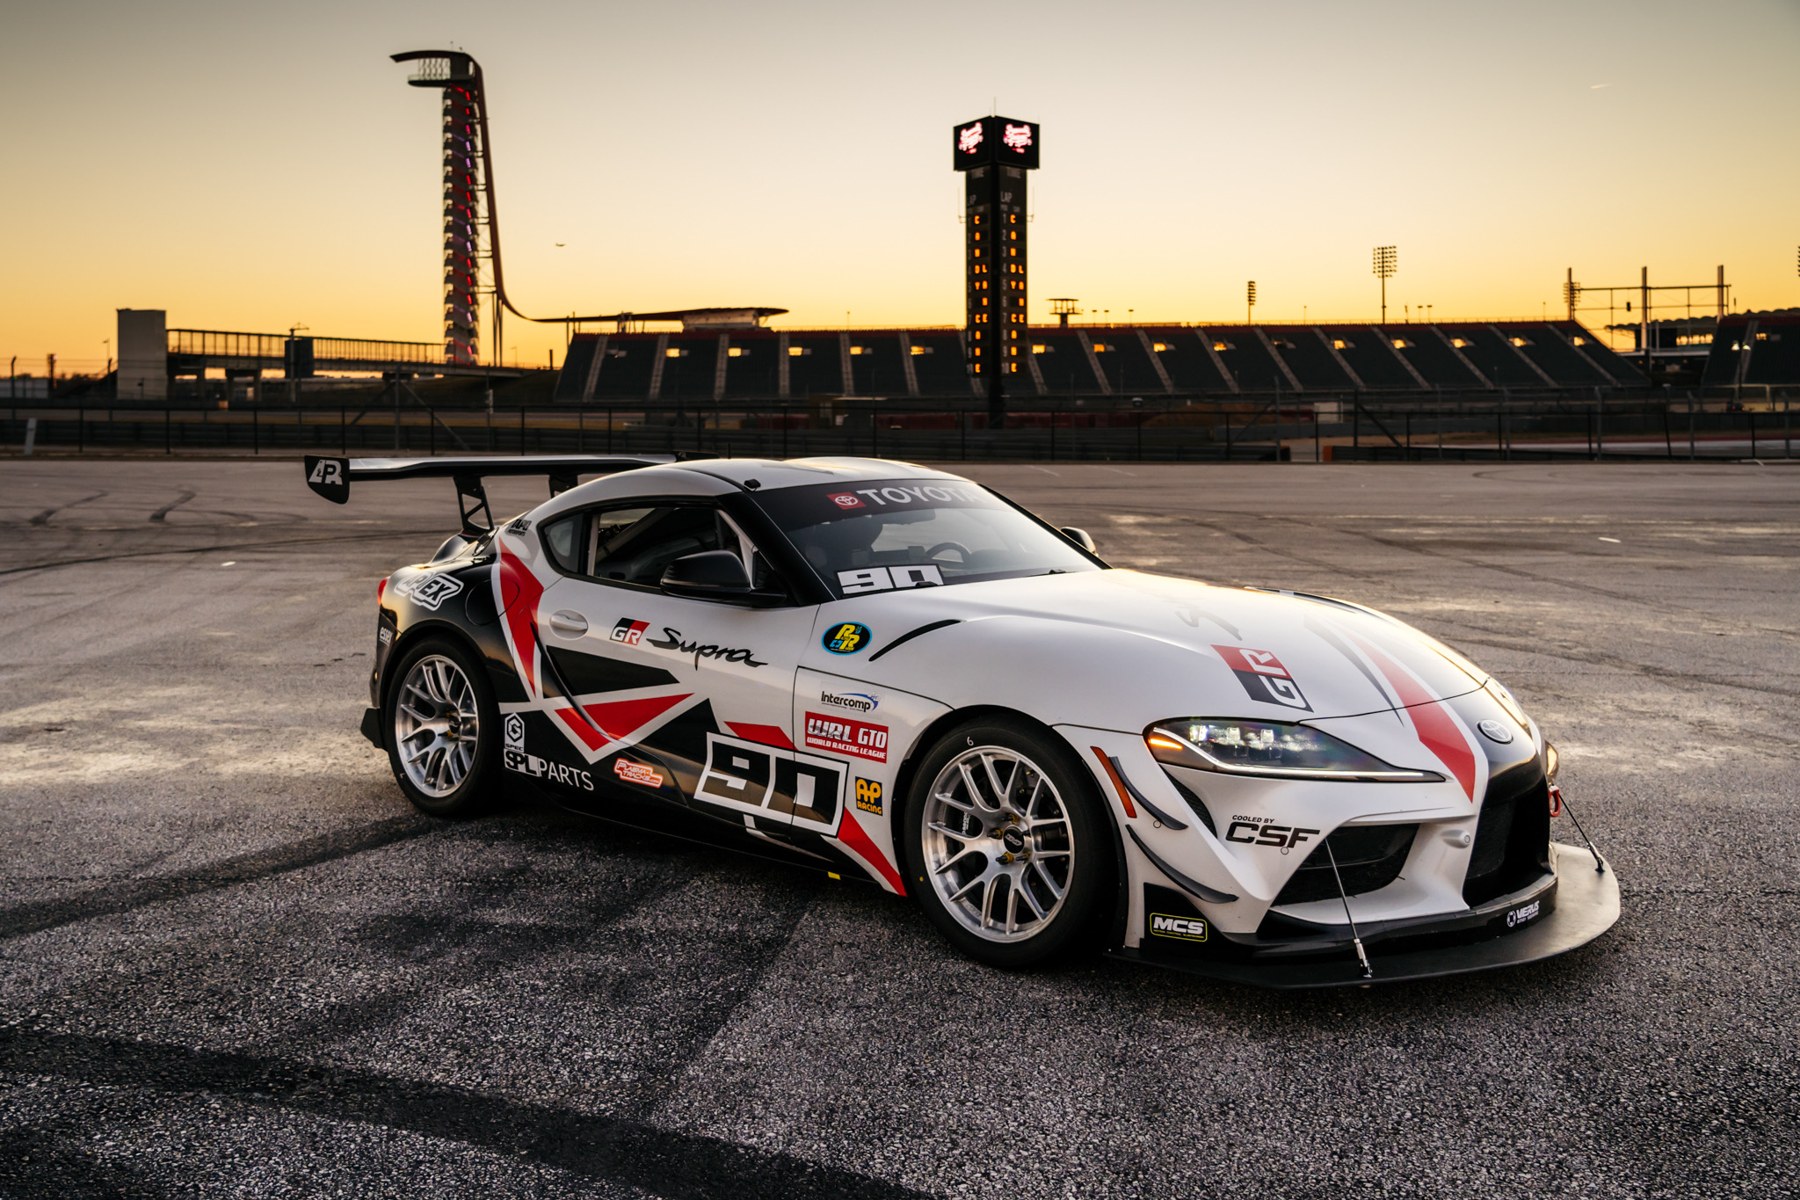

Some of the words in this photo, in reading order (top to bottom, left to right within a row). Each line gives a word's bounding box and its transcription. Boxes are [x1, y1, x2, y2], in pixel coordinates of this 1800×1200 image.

[837, 565, 945, 595] 90
[611, 627, 642, 645] GR
[646, 627, 768, 671] Supra
[1239, 648, 1307, 709] GR
[821, 690, 871, 713] Intercomp
[806, 736, 832, 747] WORLD
[832, 740, 859, 753] RACING
[860, 747, 886, 759] LEAGUE
[698, 738, 844, 830] 90
[856, 779, 881, 803] AP
[857, 801, 882, 815] RACING
[1232, 814, 1262, 823] COOLED
[1225, 821, 1321, 849] CSF
[1153, 916, 1204, 935] MCS
